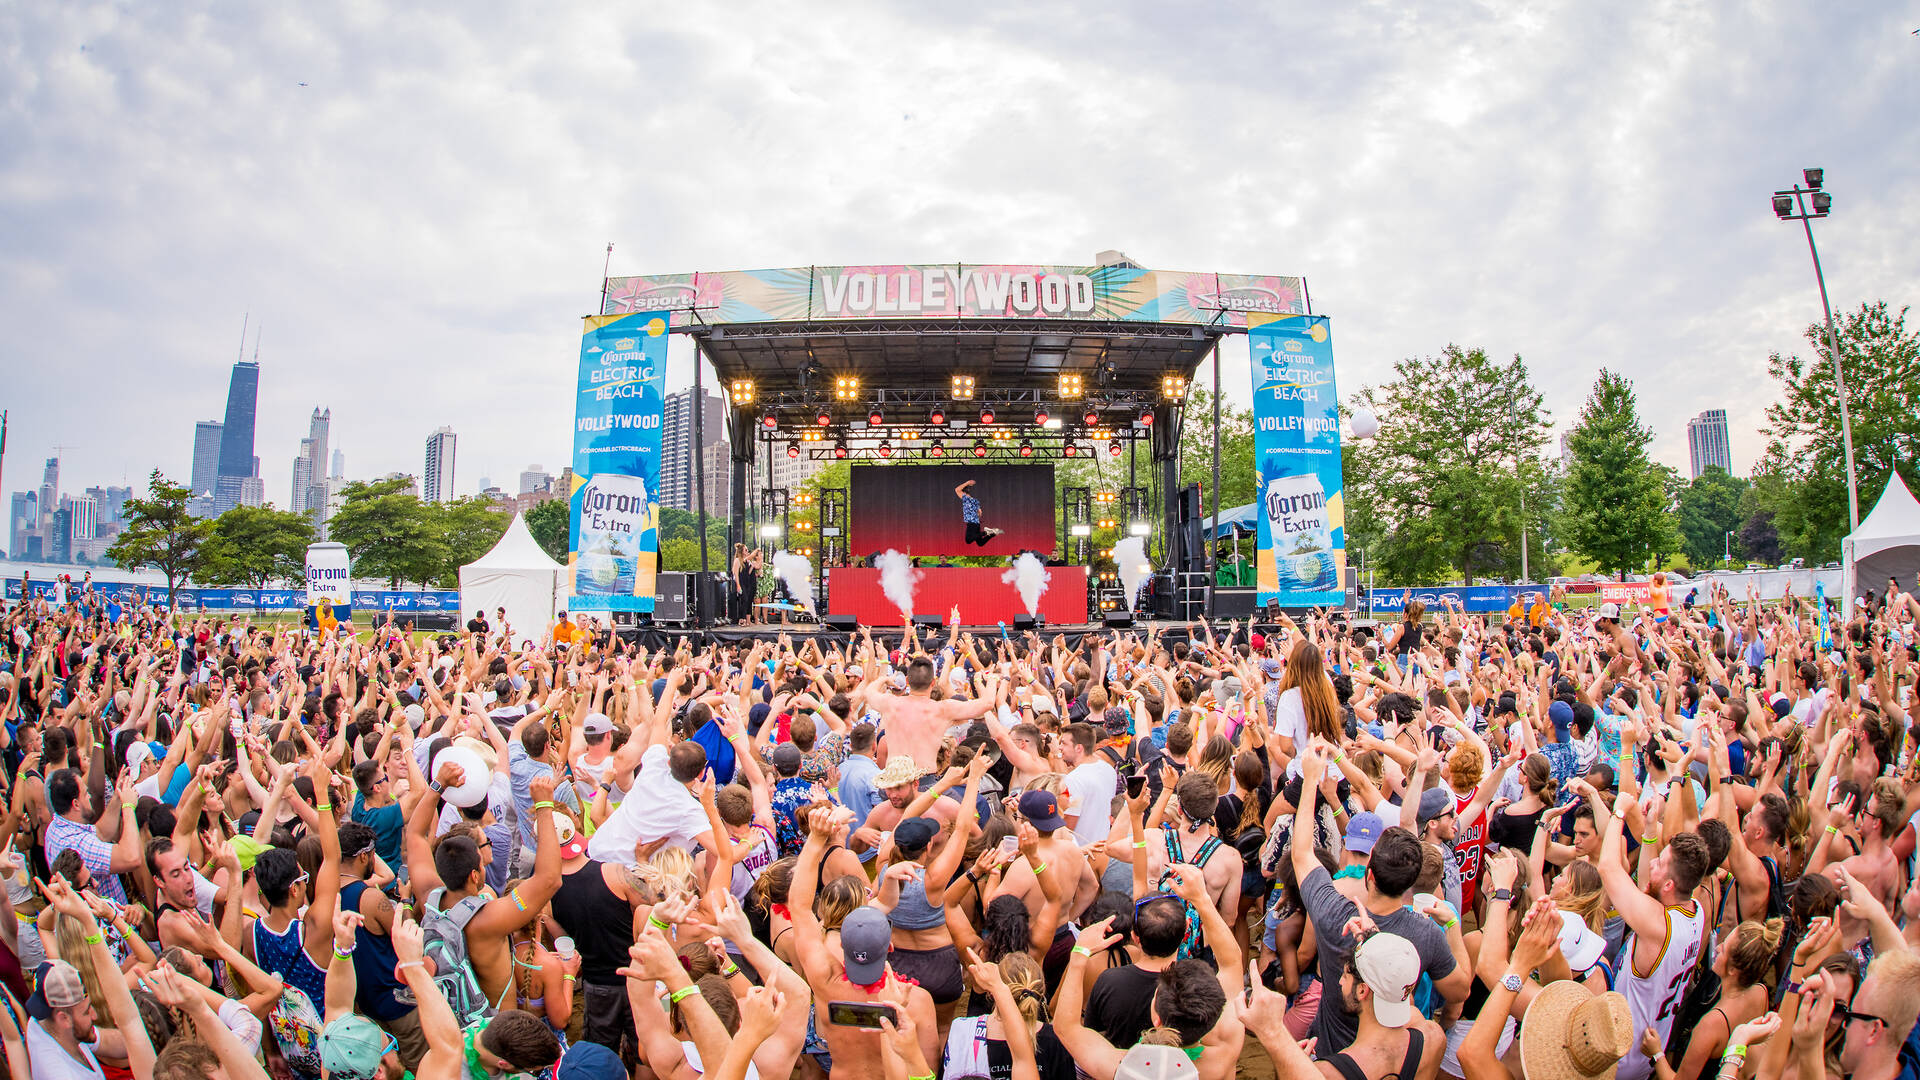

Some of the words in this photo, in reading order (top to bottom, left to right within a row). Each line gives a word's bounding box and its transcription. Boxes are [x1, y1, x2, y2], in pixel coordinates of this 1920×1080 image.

[821, 269, 1095, 315] VOLLEYWOOD
[600, 350, 646, 366] Corona
[1272, 350, 1315, 366] Corona
[591, 367, 654, 383] ELECTRIC
[1265, 367, 1324, 385] ELECTRIC
[596, 385, 644, 401] BEACH
[1274, 387, 1318, 402] BEACH
[577, 414, 660, 431] VOLLEYWOOD
[1258, 416, 1337, 432] VOLLEYWOOD
[592, 513, 631, 533] Extra
[1283, 516, 1321, 533] Extra
[306, 564, 347, 584] Corona
[313, 581, 337, 592] Extra
[384, 598, 411, 606] PLAY
[1373, 597, 1405, 607] PLAY
